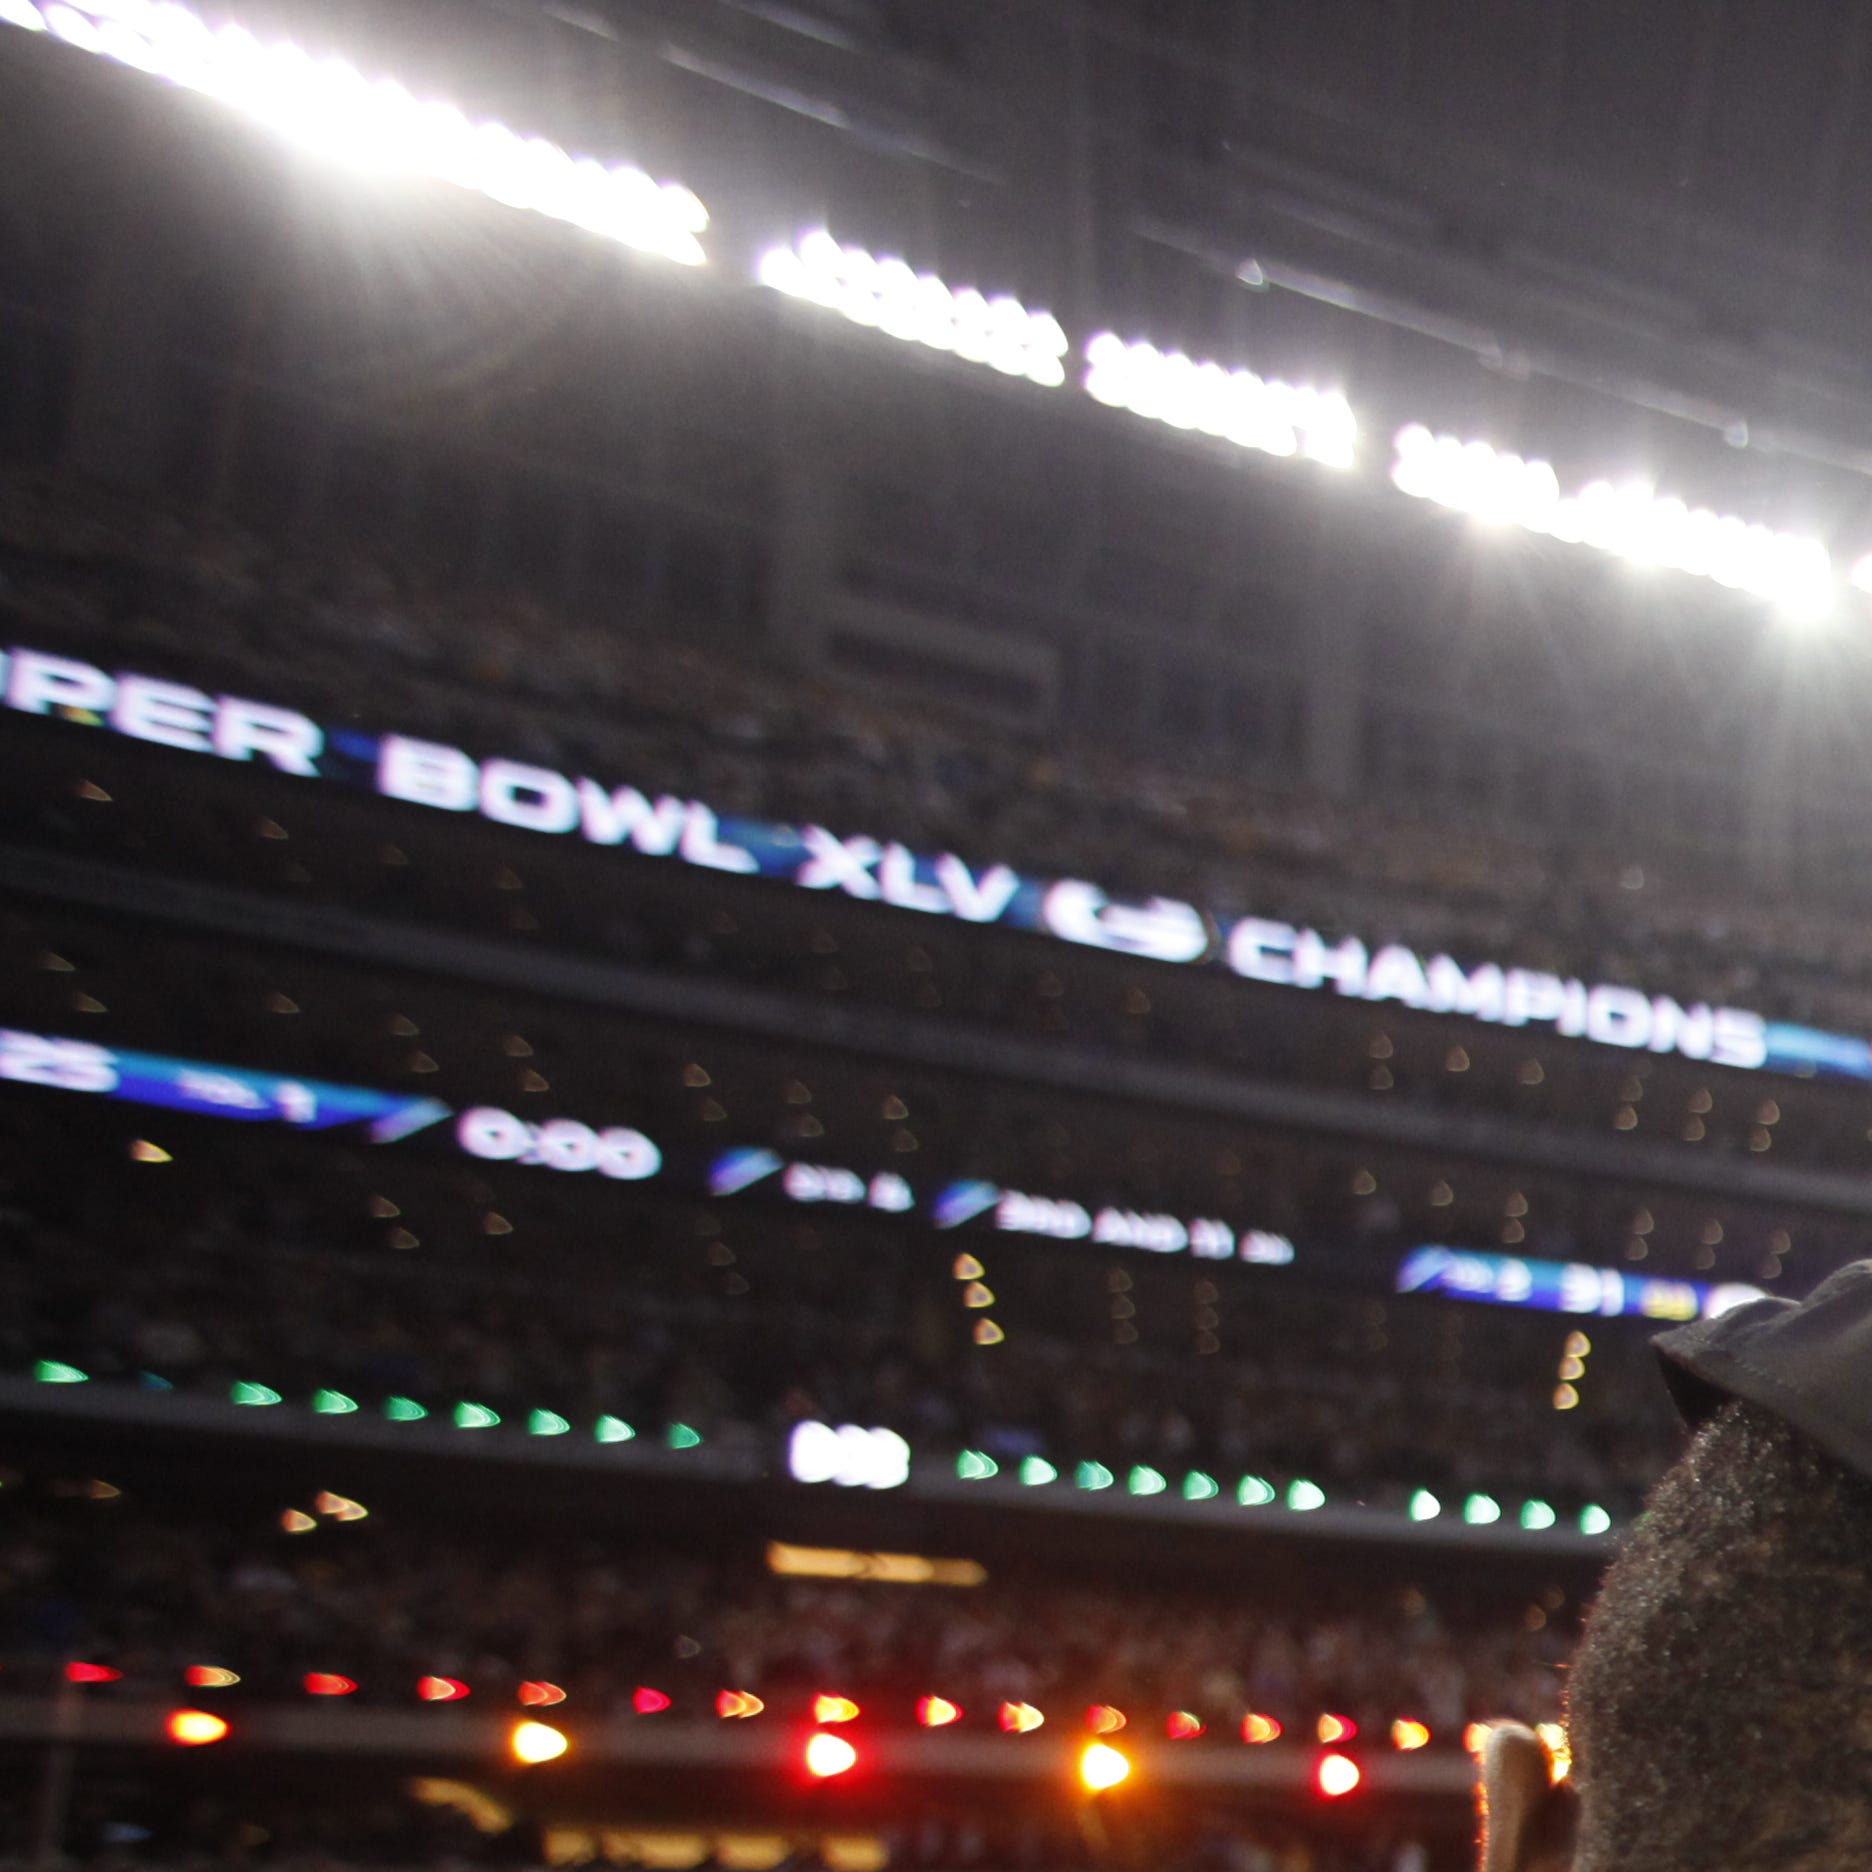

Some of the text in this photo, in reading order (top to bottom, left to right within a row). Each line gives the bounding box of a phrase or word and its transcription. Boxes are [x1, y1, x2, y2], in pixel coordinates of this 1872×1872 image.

[378, 733, 762, 874] BOWL
[797, 823, 1020, 924] XLV
[1228, 916, 1768, 1070] CHAMPIONS
